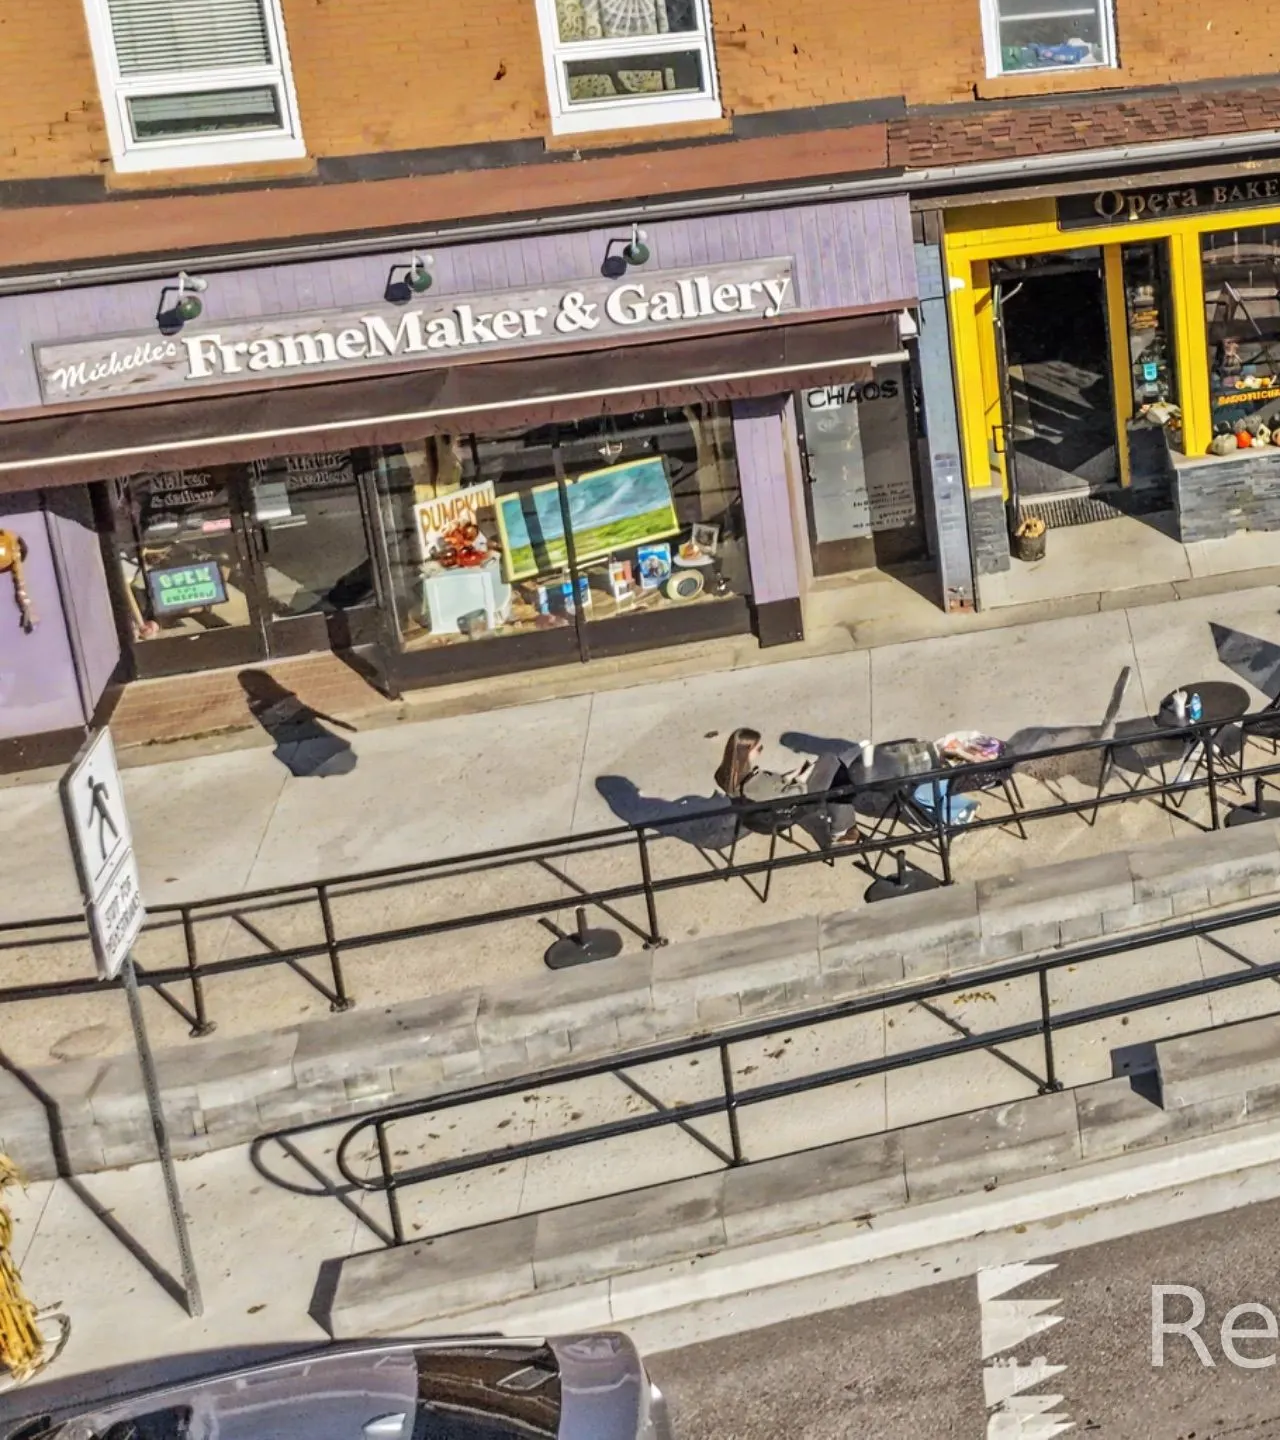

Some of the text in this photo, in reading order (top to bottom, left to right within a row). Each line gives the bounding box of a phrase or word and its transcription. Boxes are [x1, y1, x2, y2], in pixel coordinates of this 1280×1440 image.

[1094, 189, 1197, 219] Opera
[52, 275, 792, 391] Michelle's FrameMaker & Gallery
[806, 380, 899, 409] CHAOS
[160, 567, 212, 589] OPEN
